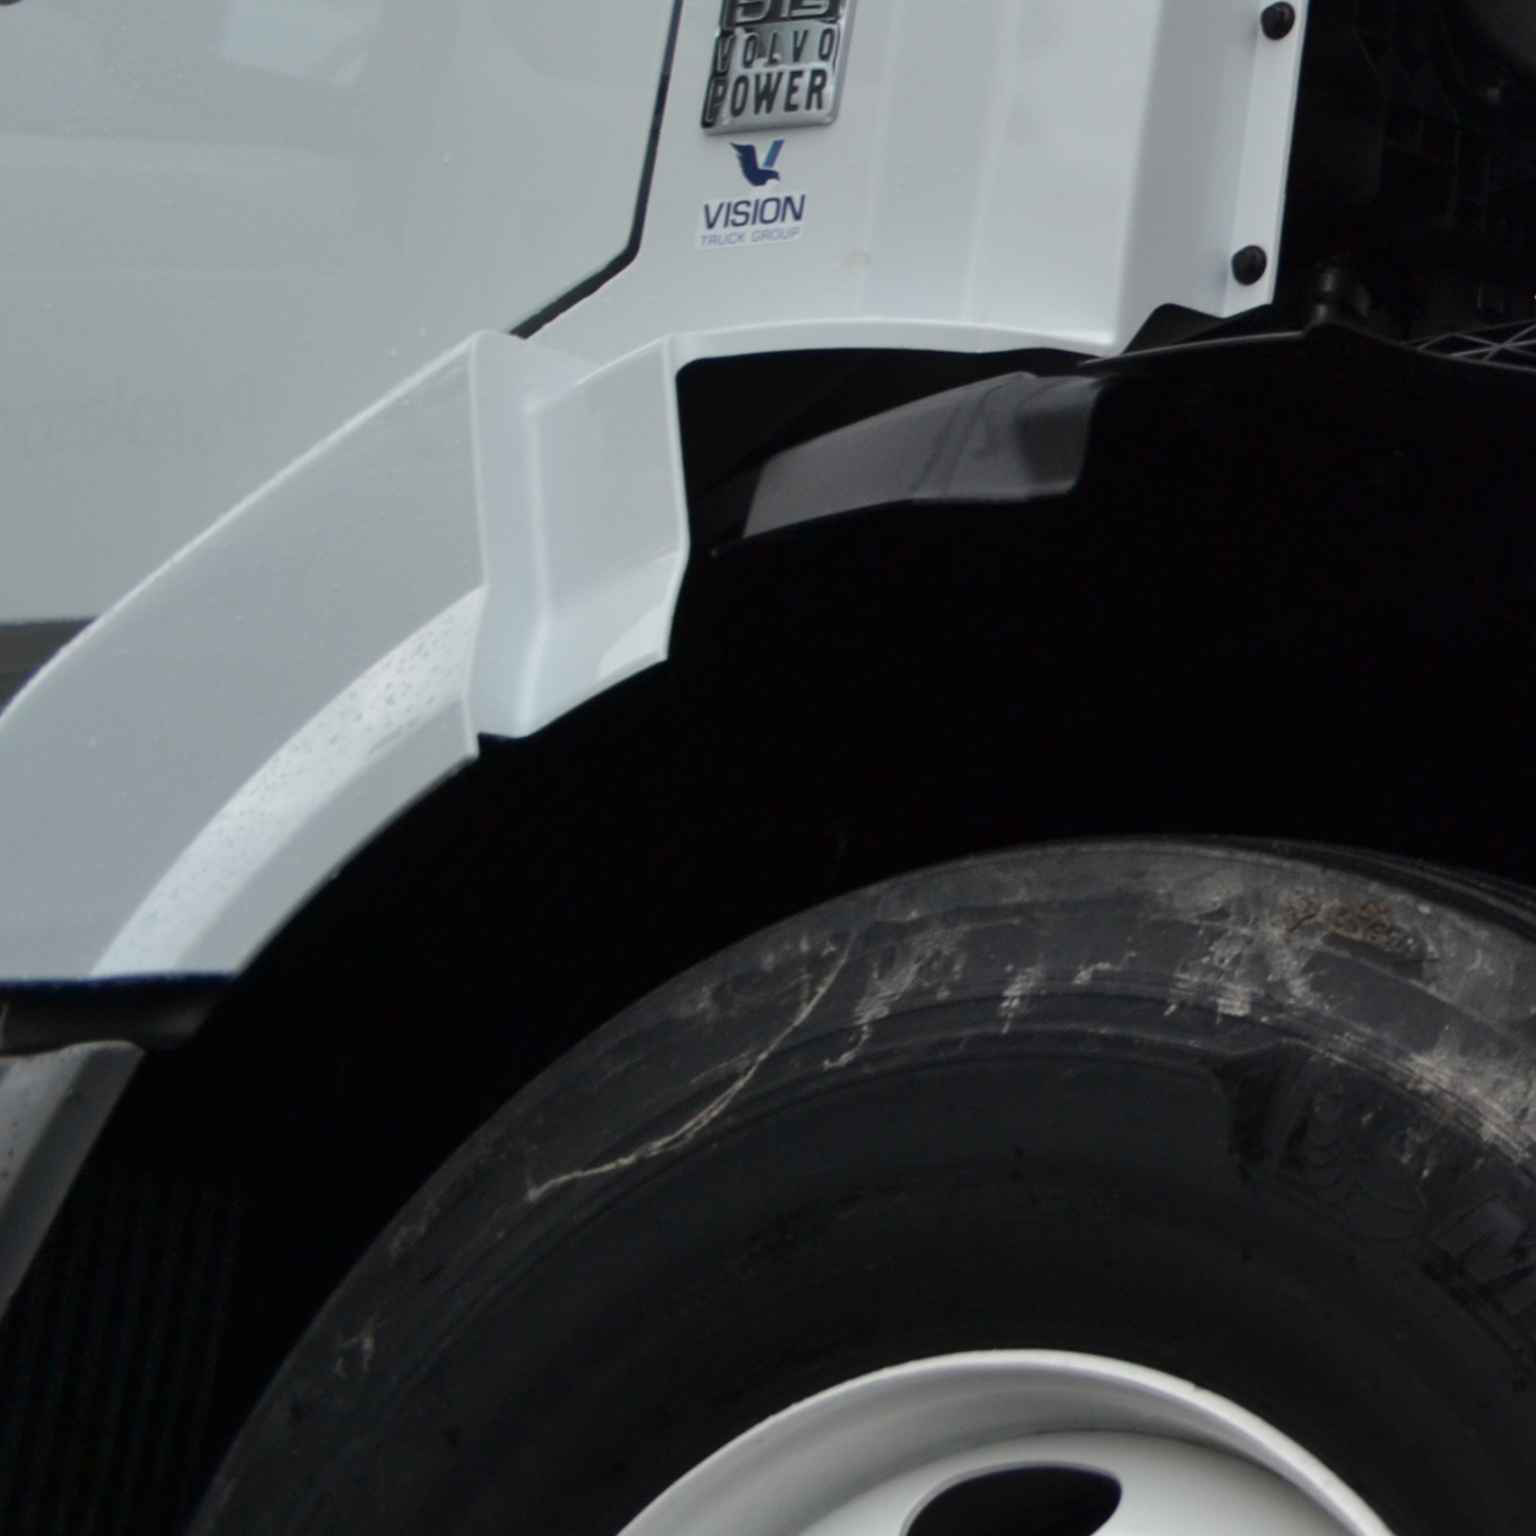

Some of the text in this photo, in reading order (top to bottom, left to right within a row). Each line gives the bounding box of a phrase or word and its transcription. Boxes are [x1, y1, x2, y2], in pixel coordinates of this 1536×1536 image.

[714, 28, 836, 75] VOLVO
[704, 69, 829, 124] POWER
[703, 194, 806, 230] VISION
[700, 226, 802, 248] TRUCK GROUP
